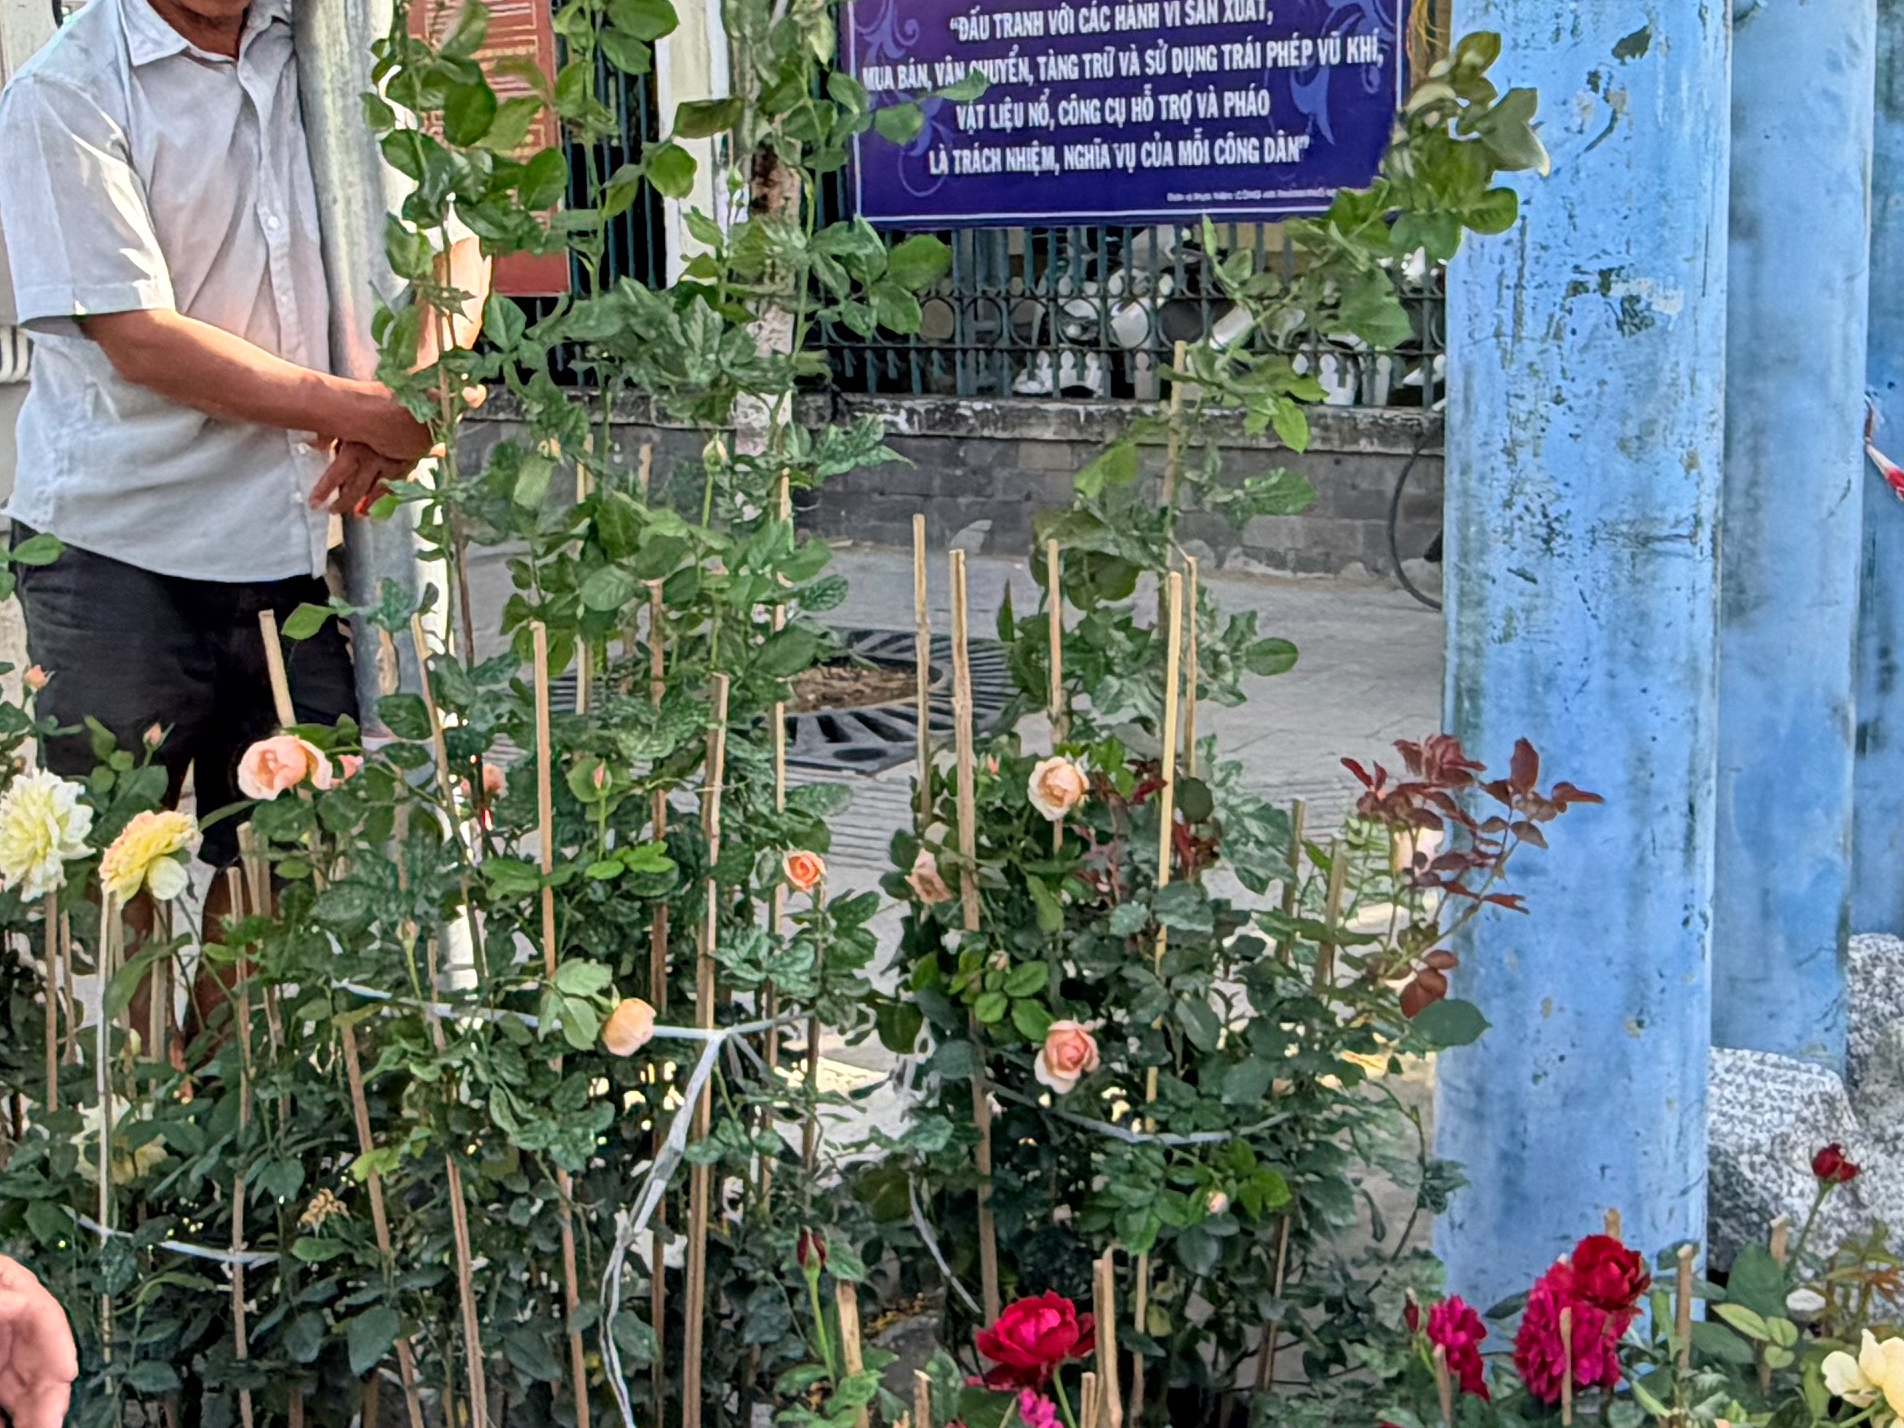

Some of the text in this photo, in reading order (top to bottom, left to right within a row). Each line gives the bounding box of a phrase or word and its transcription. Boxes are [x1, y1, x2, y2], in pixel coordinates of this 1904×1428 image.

[993, 11, 1044, 39] TRANH
[1048, 2, 1075, 35] VỚI
[1079, 0, 1111, 33] CÁC
[1163, 0, 1181, 29] VI
[863, 64, 895, 92] MUA
[897, 56, 933, 92] BÁN,
[1037, 49, 1079, 81] TÀNG
[1082, 45, 1115, 78] TRỮ
[1119, 44, 1141, 76] VÀ
[1145, 38, 1168, 76] SỬ
[1172, 45, 1218, 79] DỤNG
[1221, 34, 1262, 71] TRÁI
[1266, 31, 1313, 68] PHÉP
[1317, 30, 1340, 66] VŨ
[1346, 27, 1384, 67] KHÍ,
[956, 82, 1270, 135] VẬT LIỆU NỔ, CÔNG CỤ HỖ TRỢ VÀ PHÁO
[929, 143, 948, 174] LÀ
[952, 141, 1002, 174] TRÁCH
[1006, 139, 1060, 176] NHIỆM,
[1063, 137, 1111, 171] NGHĨA
[1115, 143, 1136, 174] VỤ
[1141, 131, 1174, 167] CỦA
[1178, 127, 1210, 166] MỖI
[1214, 131, 1260, 165] CÔNG
